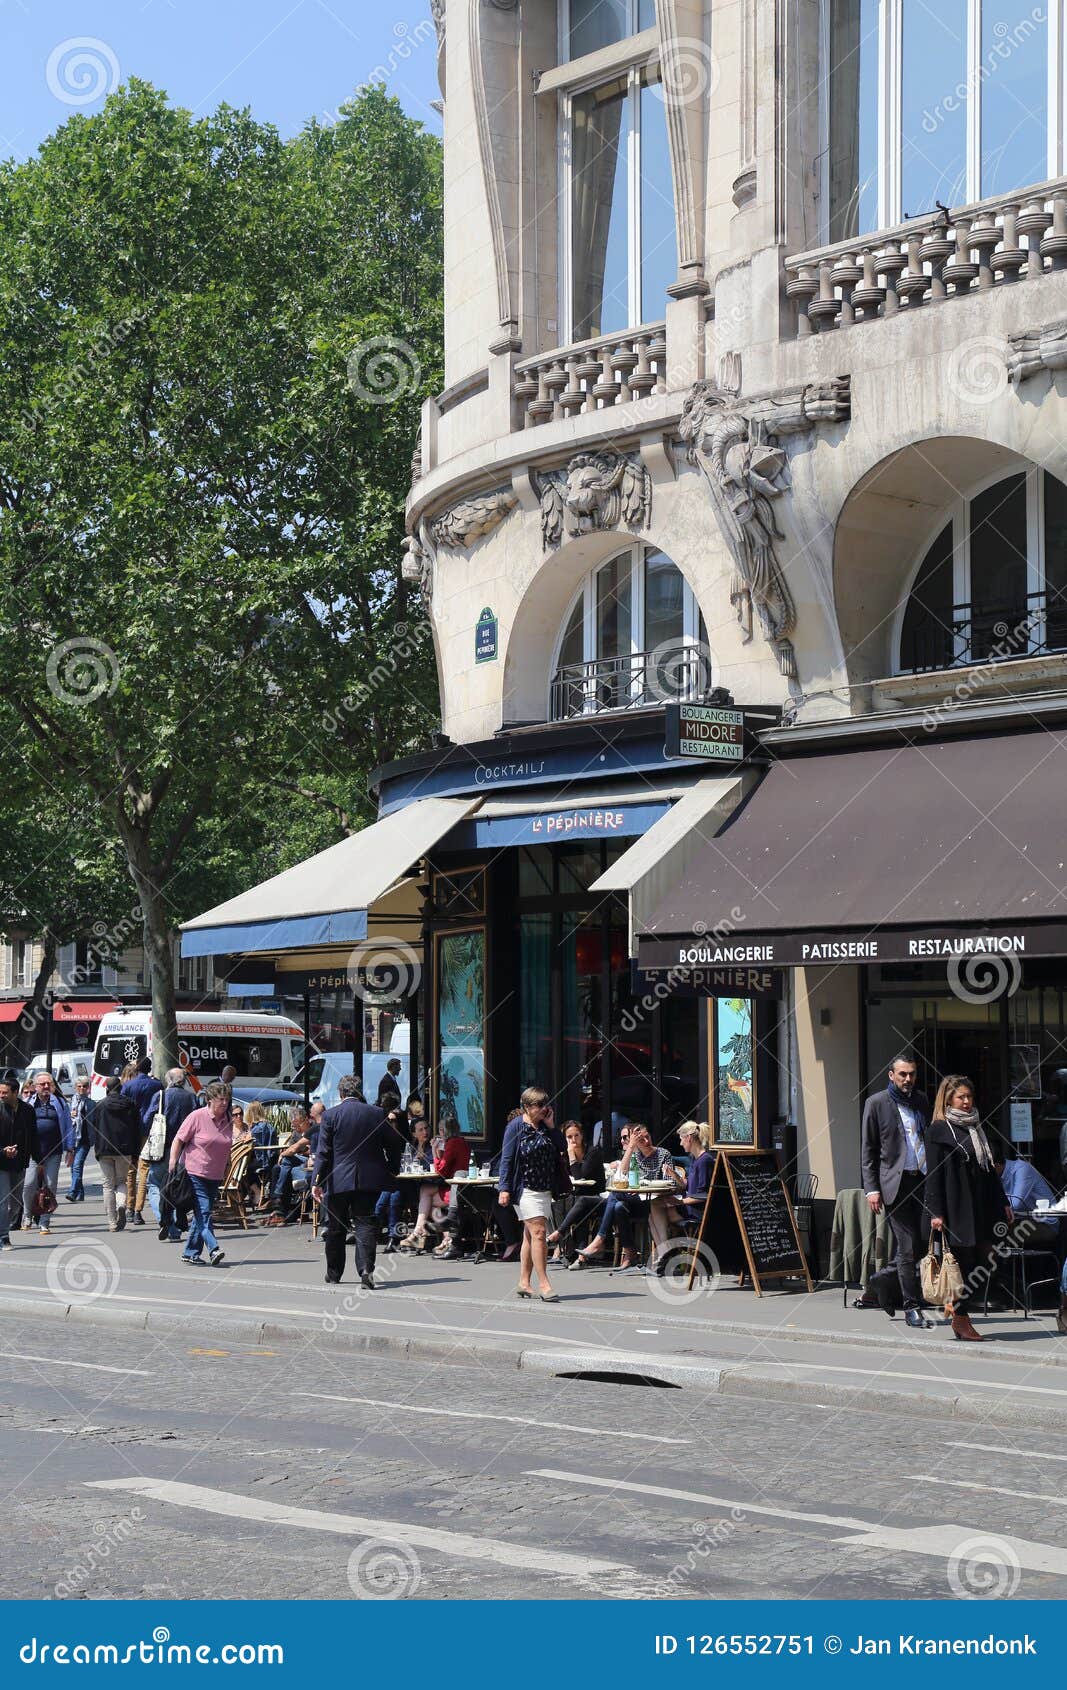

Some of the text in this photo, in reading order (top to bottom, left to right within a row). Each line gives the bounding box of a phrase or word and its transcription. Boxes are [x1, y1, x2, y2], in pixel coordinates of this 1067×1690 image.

[682, 708, 741, 723] BOULANGERIE
[682, 742, 740, 756] RESTAURANT
[679, 935, 1025, 963] BOULANGERIE PATISSERIE RESTAURATION
[103, 1024, 144, 1032] AMBULANCE
[190, 1046, 228, 1060] Delta
